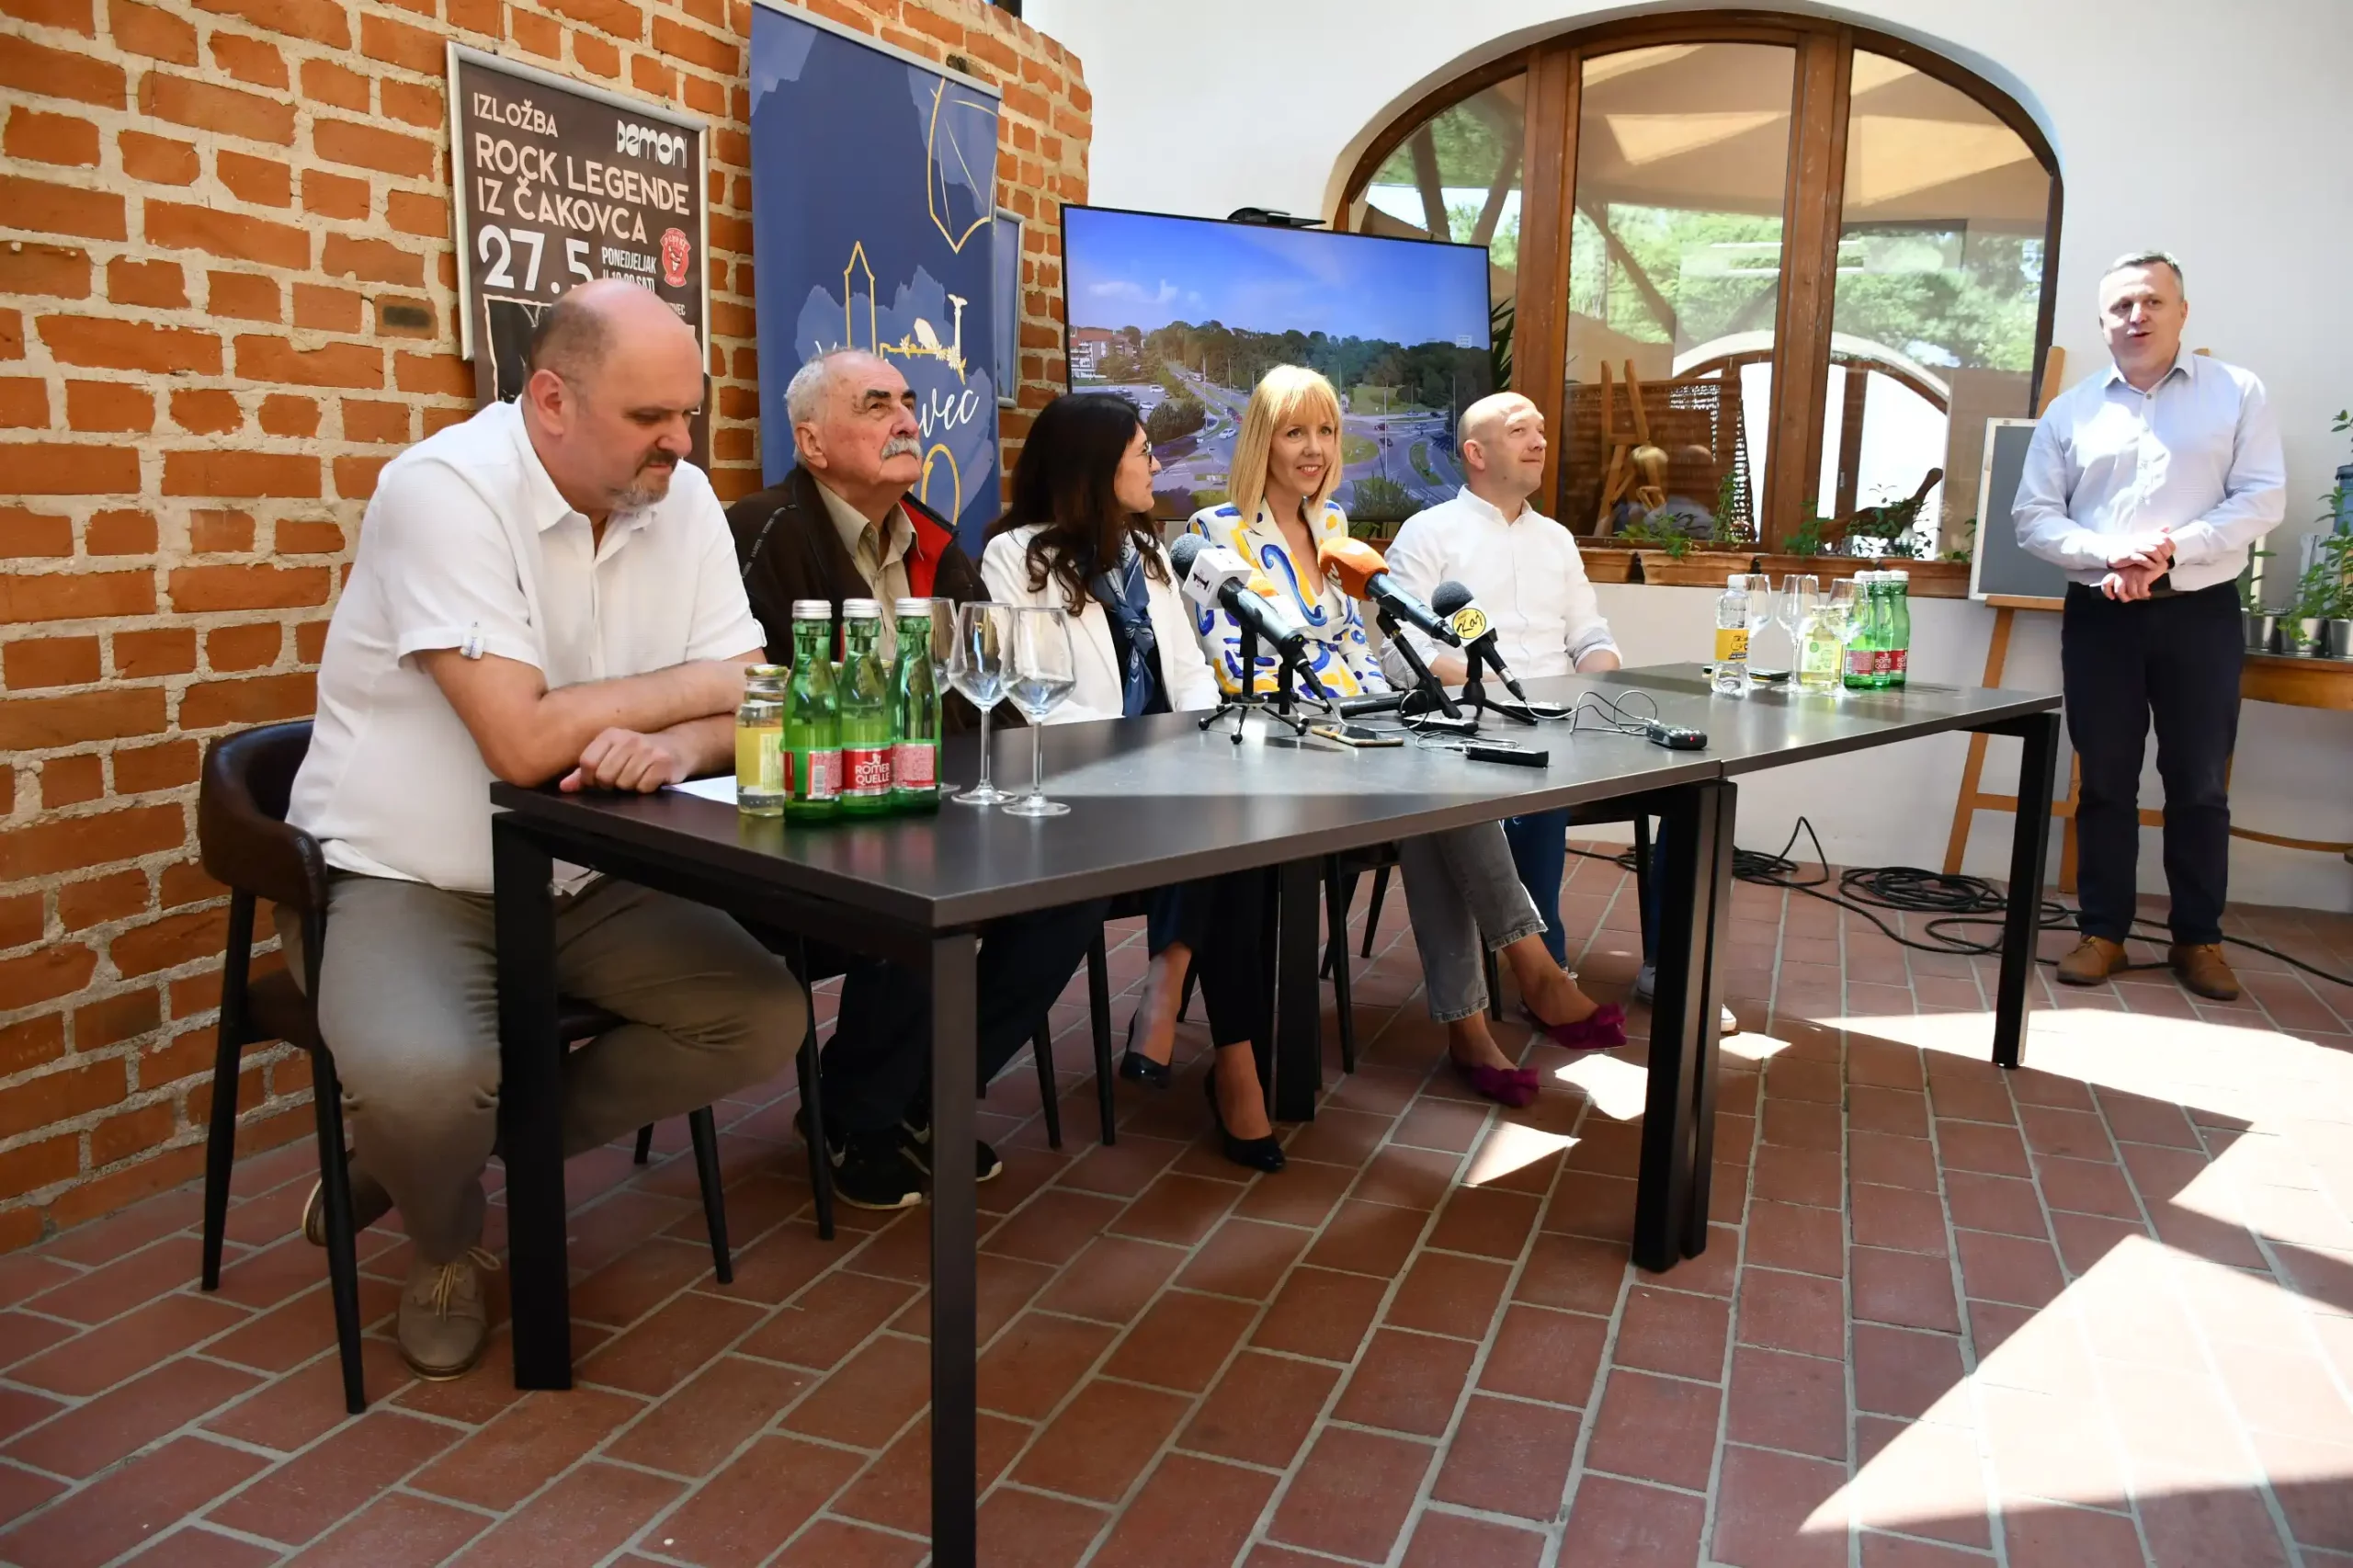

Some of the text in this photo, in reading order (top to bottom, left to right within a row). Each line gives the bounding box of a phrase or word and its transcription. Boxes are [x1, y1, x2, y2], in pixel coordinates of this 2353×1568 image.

[473, 92, 559, 138] IZLOŽBA
[475, 132, 690, 216] ROCK LEGENDE
[477, 175, 648, 244] IZ ČAKOVCA
[601, 245, 657, 275] PONEDJELJAK
[855, 772, 890, 786] QUELLE
